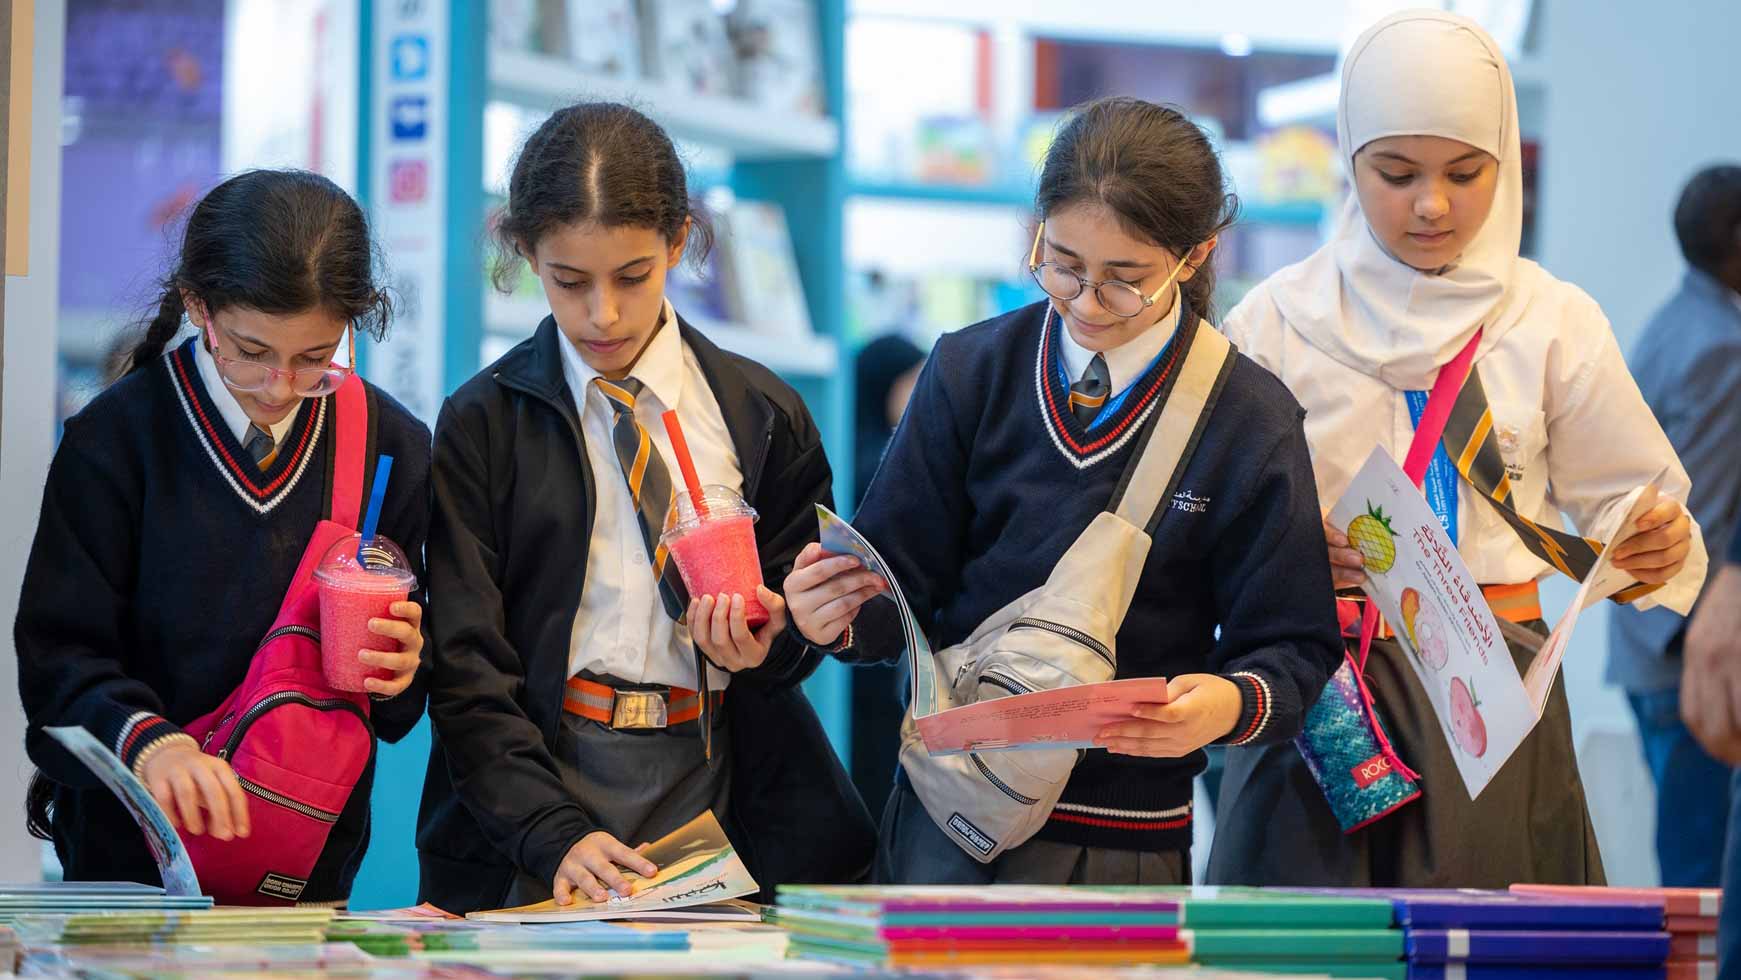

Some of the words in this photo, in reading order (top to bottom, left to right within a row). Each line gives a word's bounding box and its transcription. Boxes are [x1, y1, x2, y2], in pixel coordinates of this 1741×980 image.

[1411, 528, 1431, 560] The
[1431, 560, 1459, 607] Three
[1458, 607, 1489, 666] Friends
